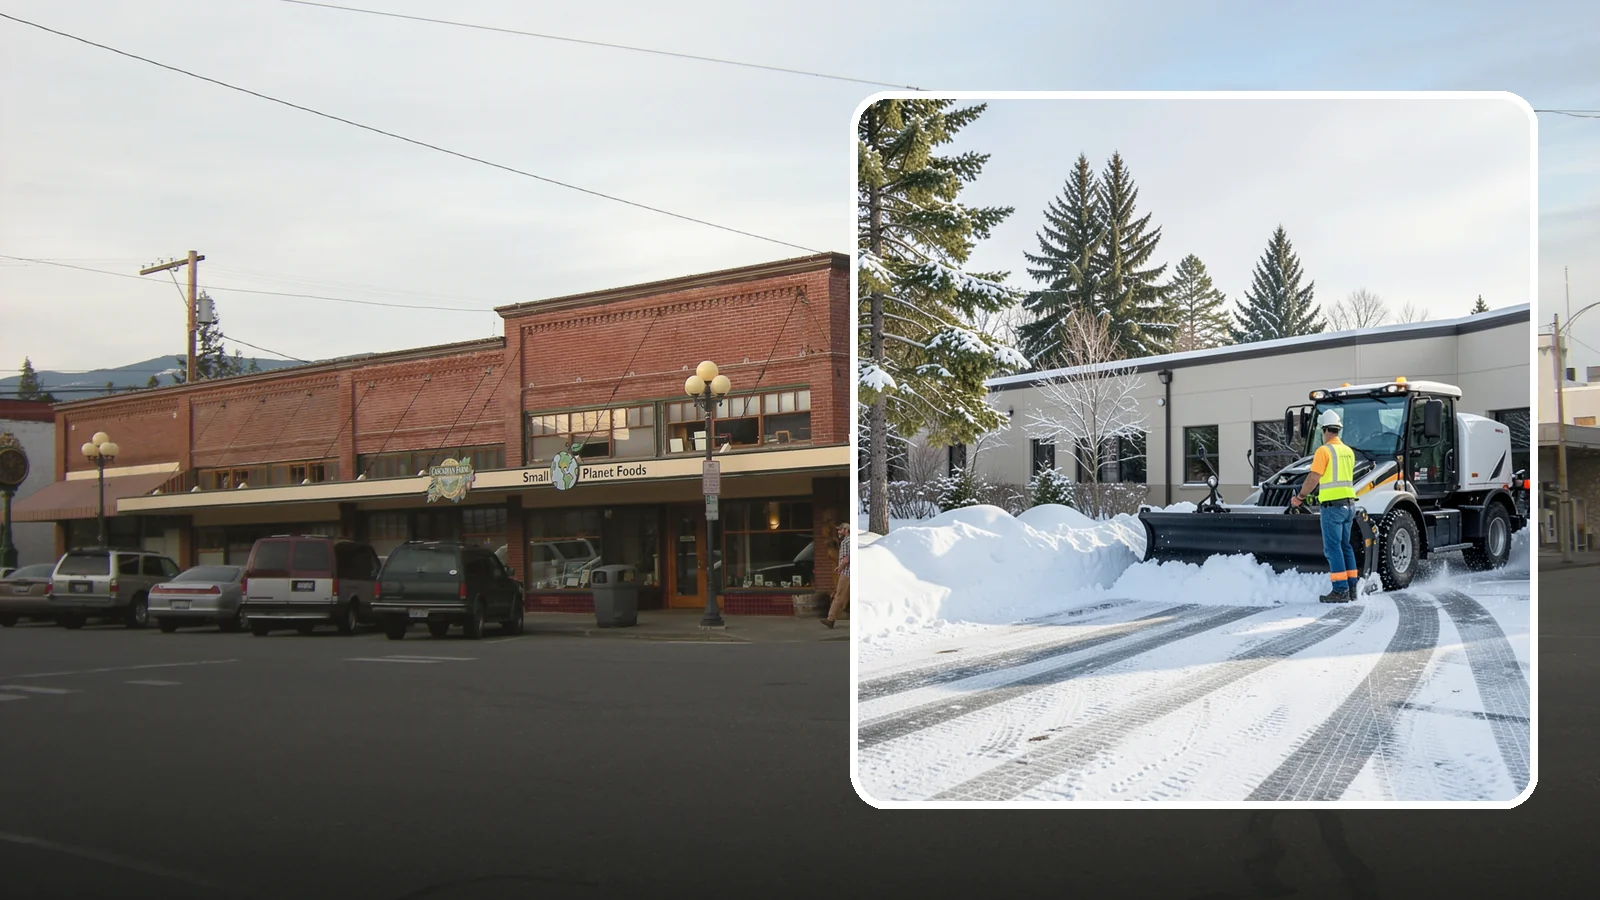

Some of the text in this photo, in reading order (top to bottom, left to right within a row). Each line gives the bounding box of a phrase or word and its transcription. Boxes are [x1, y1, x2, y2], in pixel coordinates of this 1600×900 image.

[431, 465, 469, 476] CASCADIAN FARM
[523, 464, 647, 483] Small Planet Foods
